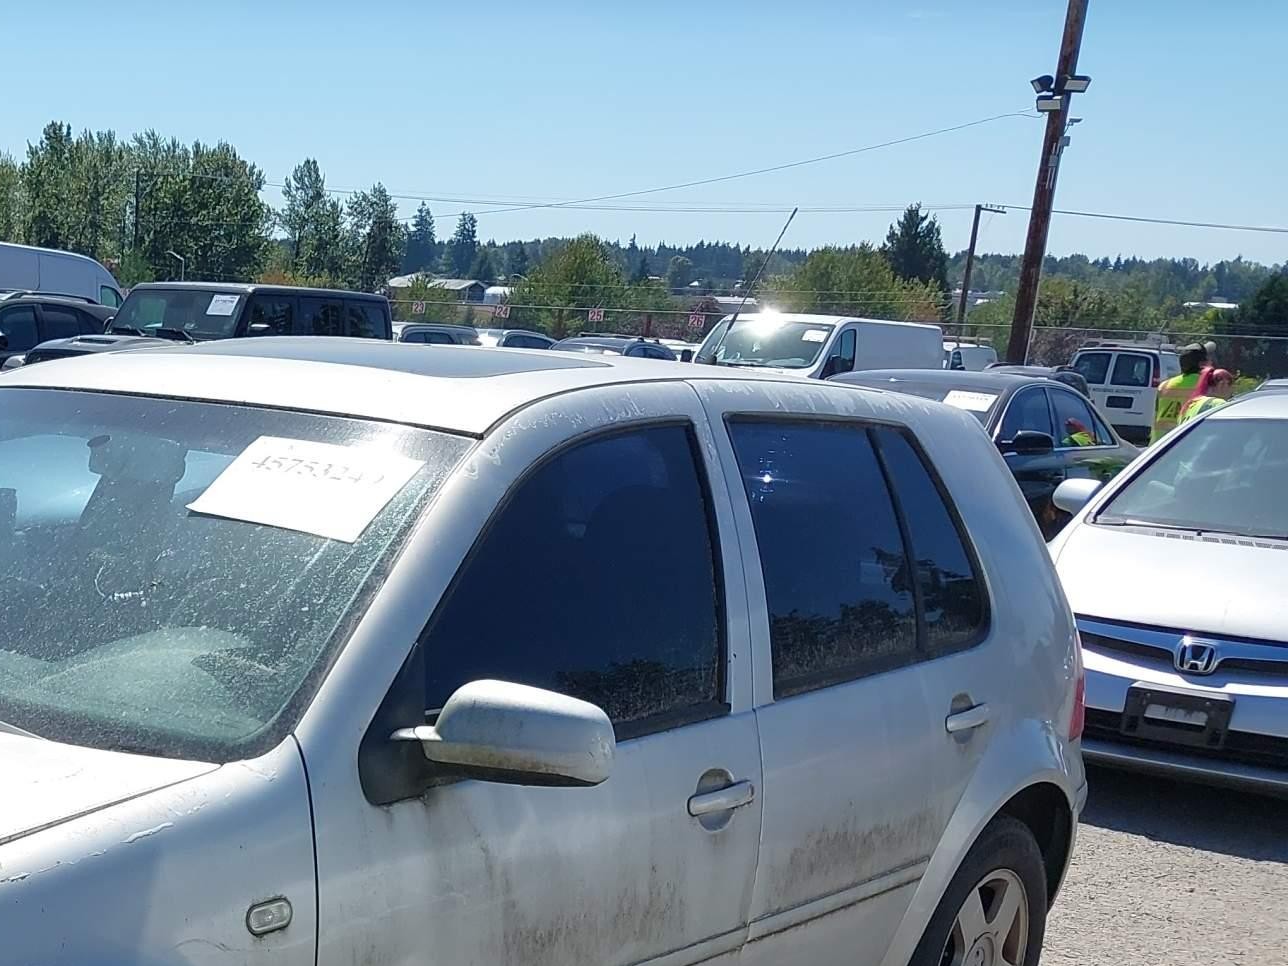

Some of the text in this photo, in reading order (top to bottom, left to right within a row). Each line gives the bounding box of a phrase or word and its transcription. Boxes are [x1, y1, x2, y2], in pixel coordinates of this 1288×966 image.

[413, 303, 425, 313] 23
[497, 307, 509, 317] 24
[590, 310, 602, 321] 25
[690, 316, 703, 327] 26
